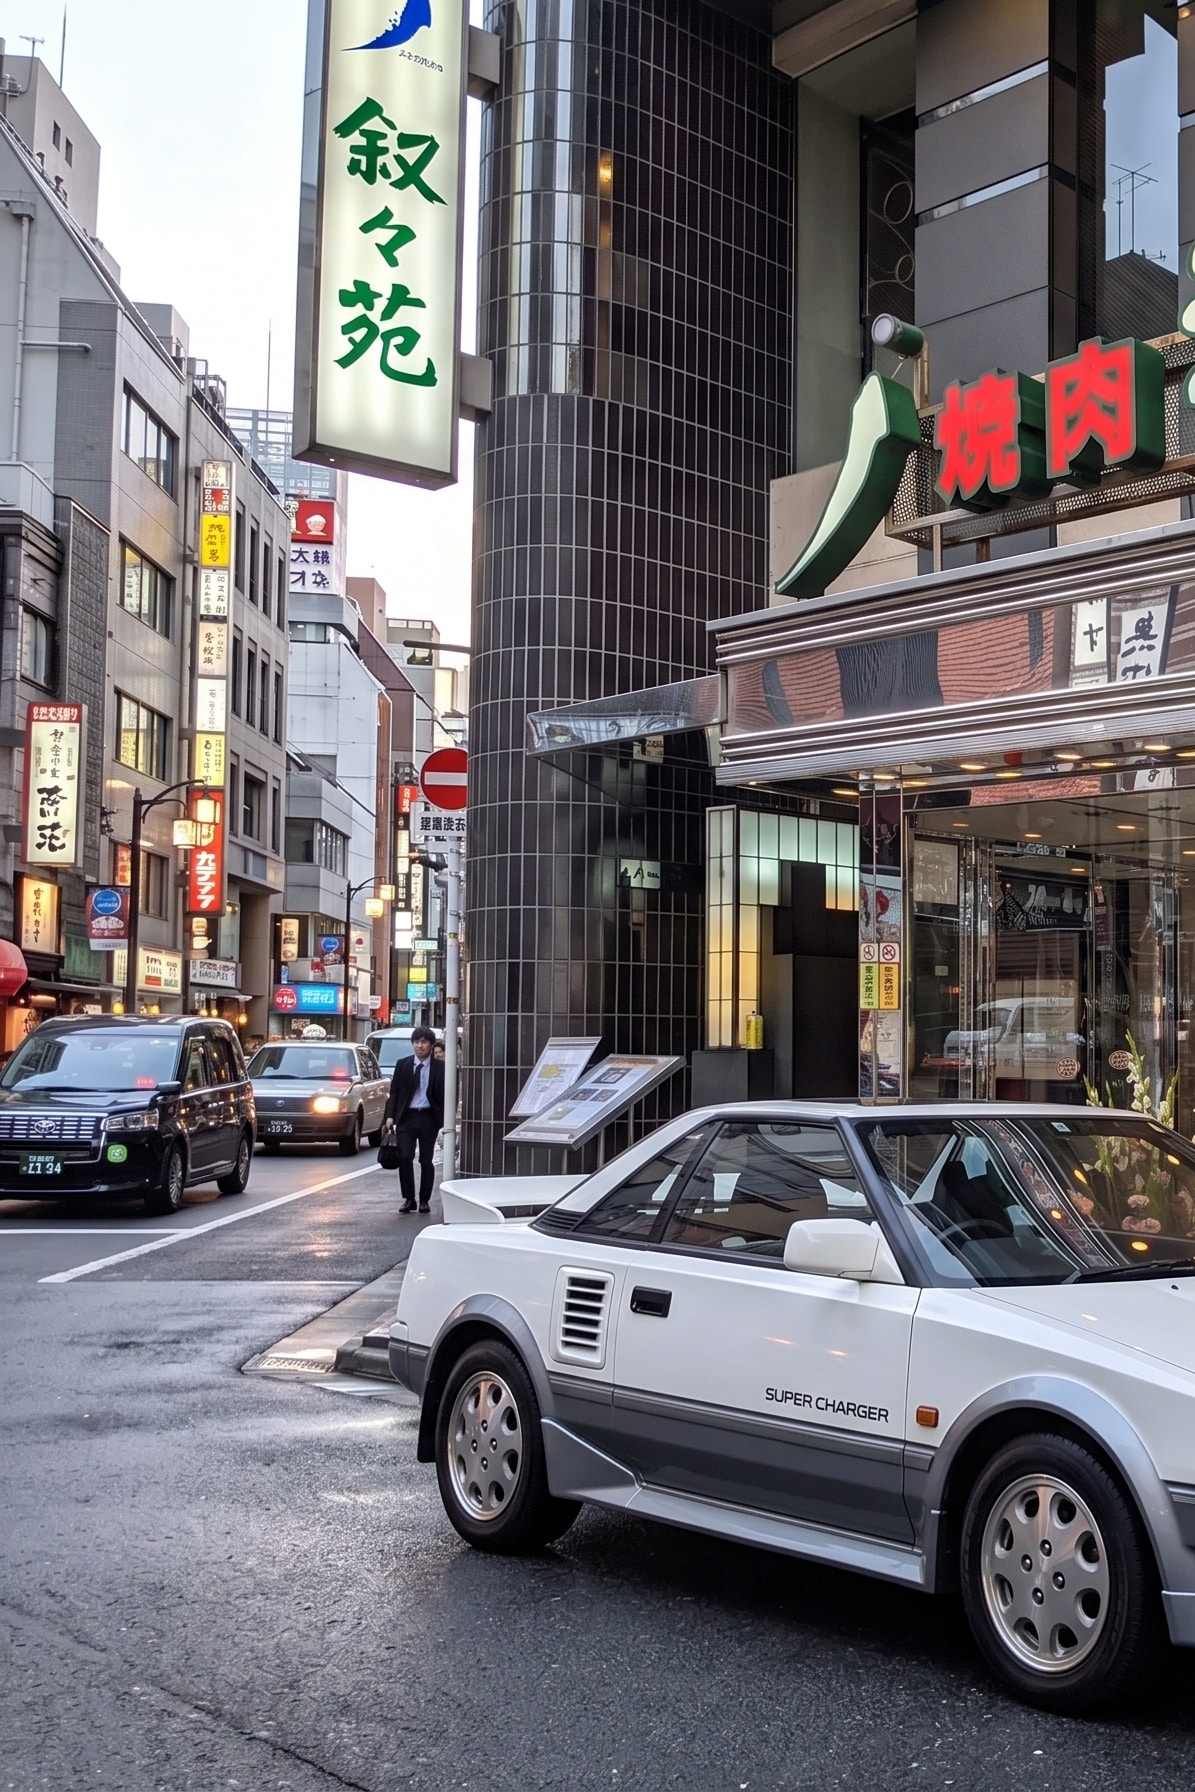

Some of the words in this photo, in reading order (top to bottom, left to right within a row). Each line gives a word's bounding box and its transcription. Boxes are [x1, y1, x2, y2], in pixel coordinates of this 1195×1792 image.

[332, 97, 448, 387] 叙々苑
[934, 338, 1136, 504] 焼肉
[765, 1387, 813, 1408] SUPER
[815, 1397, 889, 1423] CHARGER
